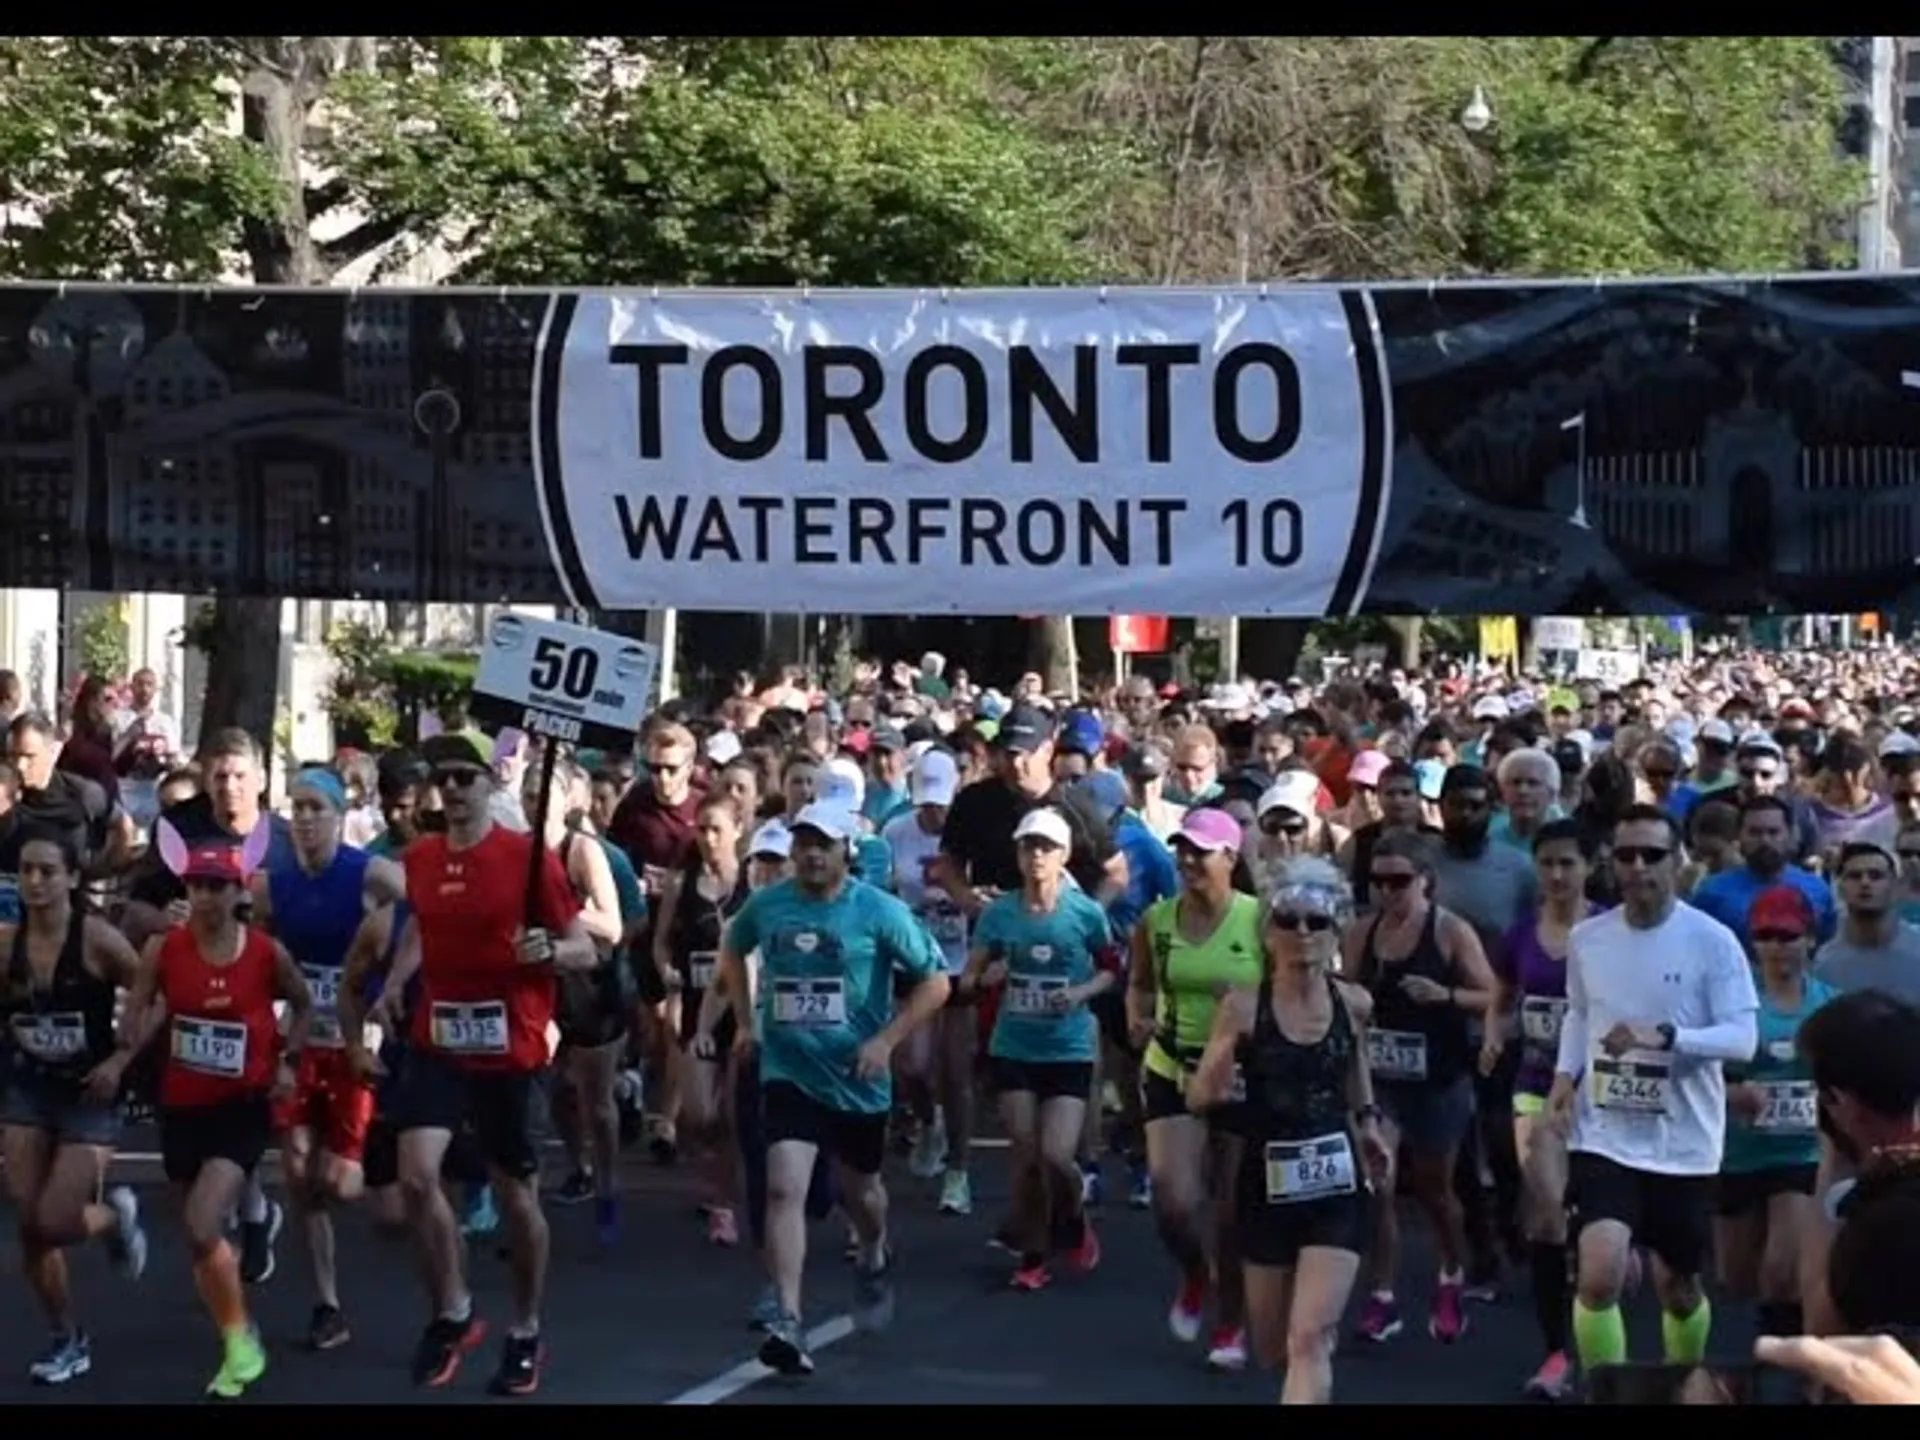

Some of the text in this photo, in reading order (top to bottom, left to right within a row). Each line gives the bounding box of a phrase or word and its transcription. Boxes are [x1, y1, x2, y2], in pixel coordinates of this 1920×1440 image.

[609, 342, 1302, 463] TORONTO
[614, 495, 1303, 567] WATERFRONT 10
[529, 636, 599, 700] 50
[521, 708, 582, 741] PACER
[795, 994, 830, 1014] 729
[188, 1036, 236, 1060] 1190
[1607, 1077, 1661, 1100] 4346
[1297, 1156, 1337, 1181] 826
